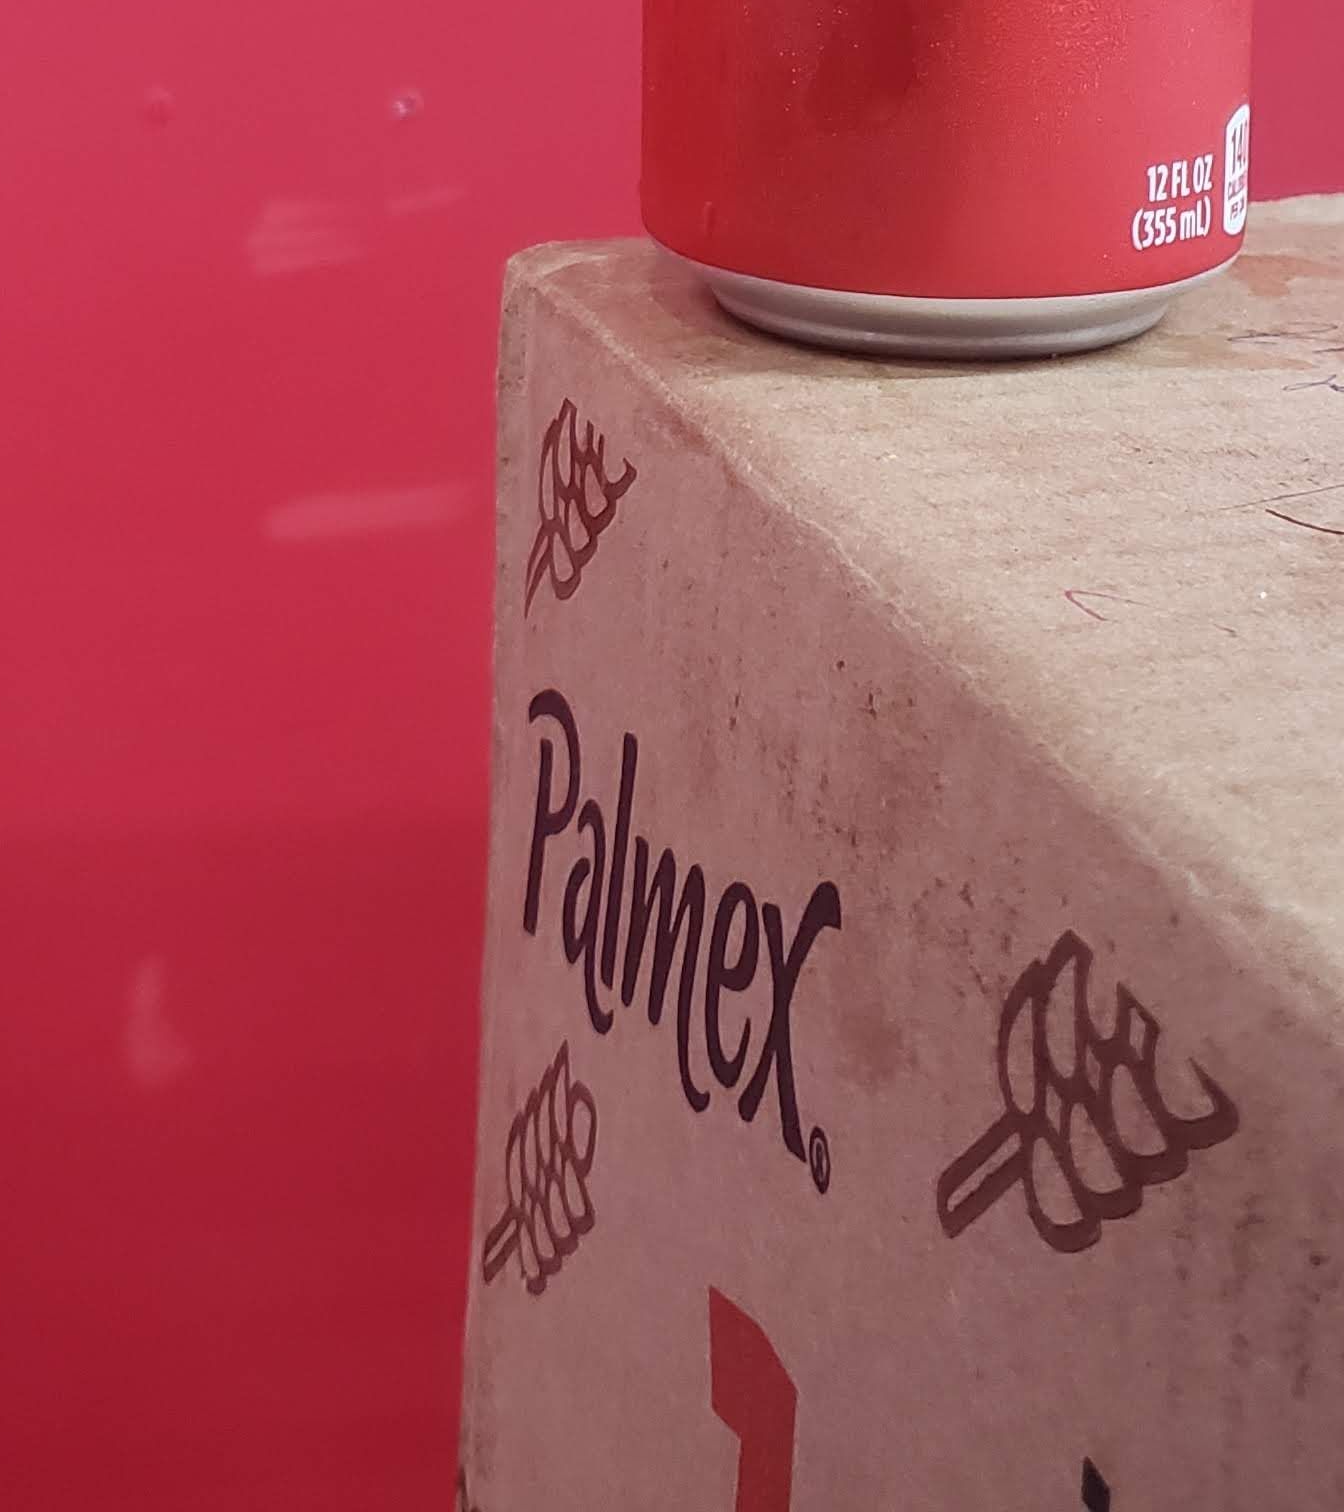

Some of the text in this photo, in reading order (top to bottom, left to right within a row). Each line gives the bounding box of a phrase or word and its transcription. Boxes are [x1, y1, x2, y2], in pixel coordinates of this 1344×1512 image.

[1146, 163, 1169, 203] 12
[1171, 159, 1191, 199] FL
[1192, 153, 1214, 193] OZ
[1131, 206, 1178, 252] (355
[1179, 194, 1212, 241] mL)
